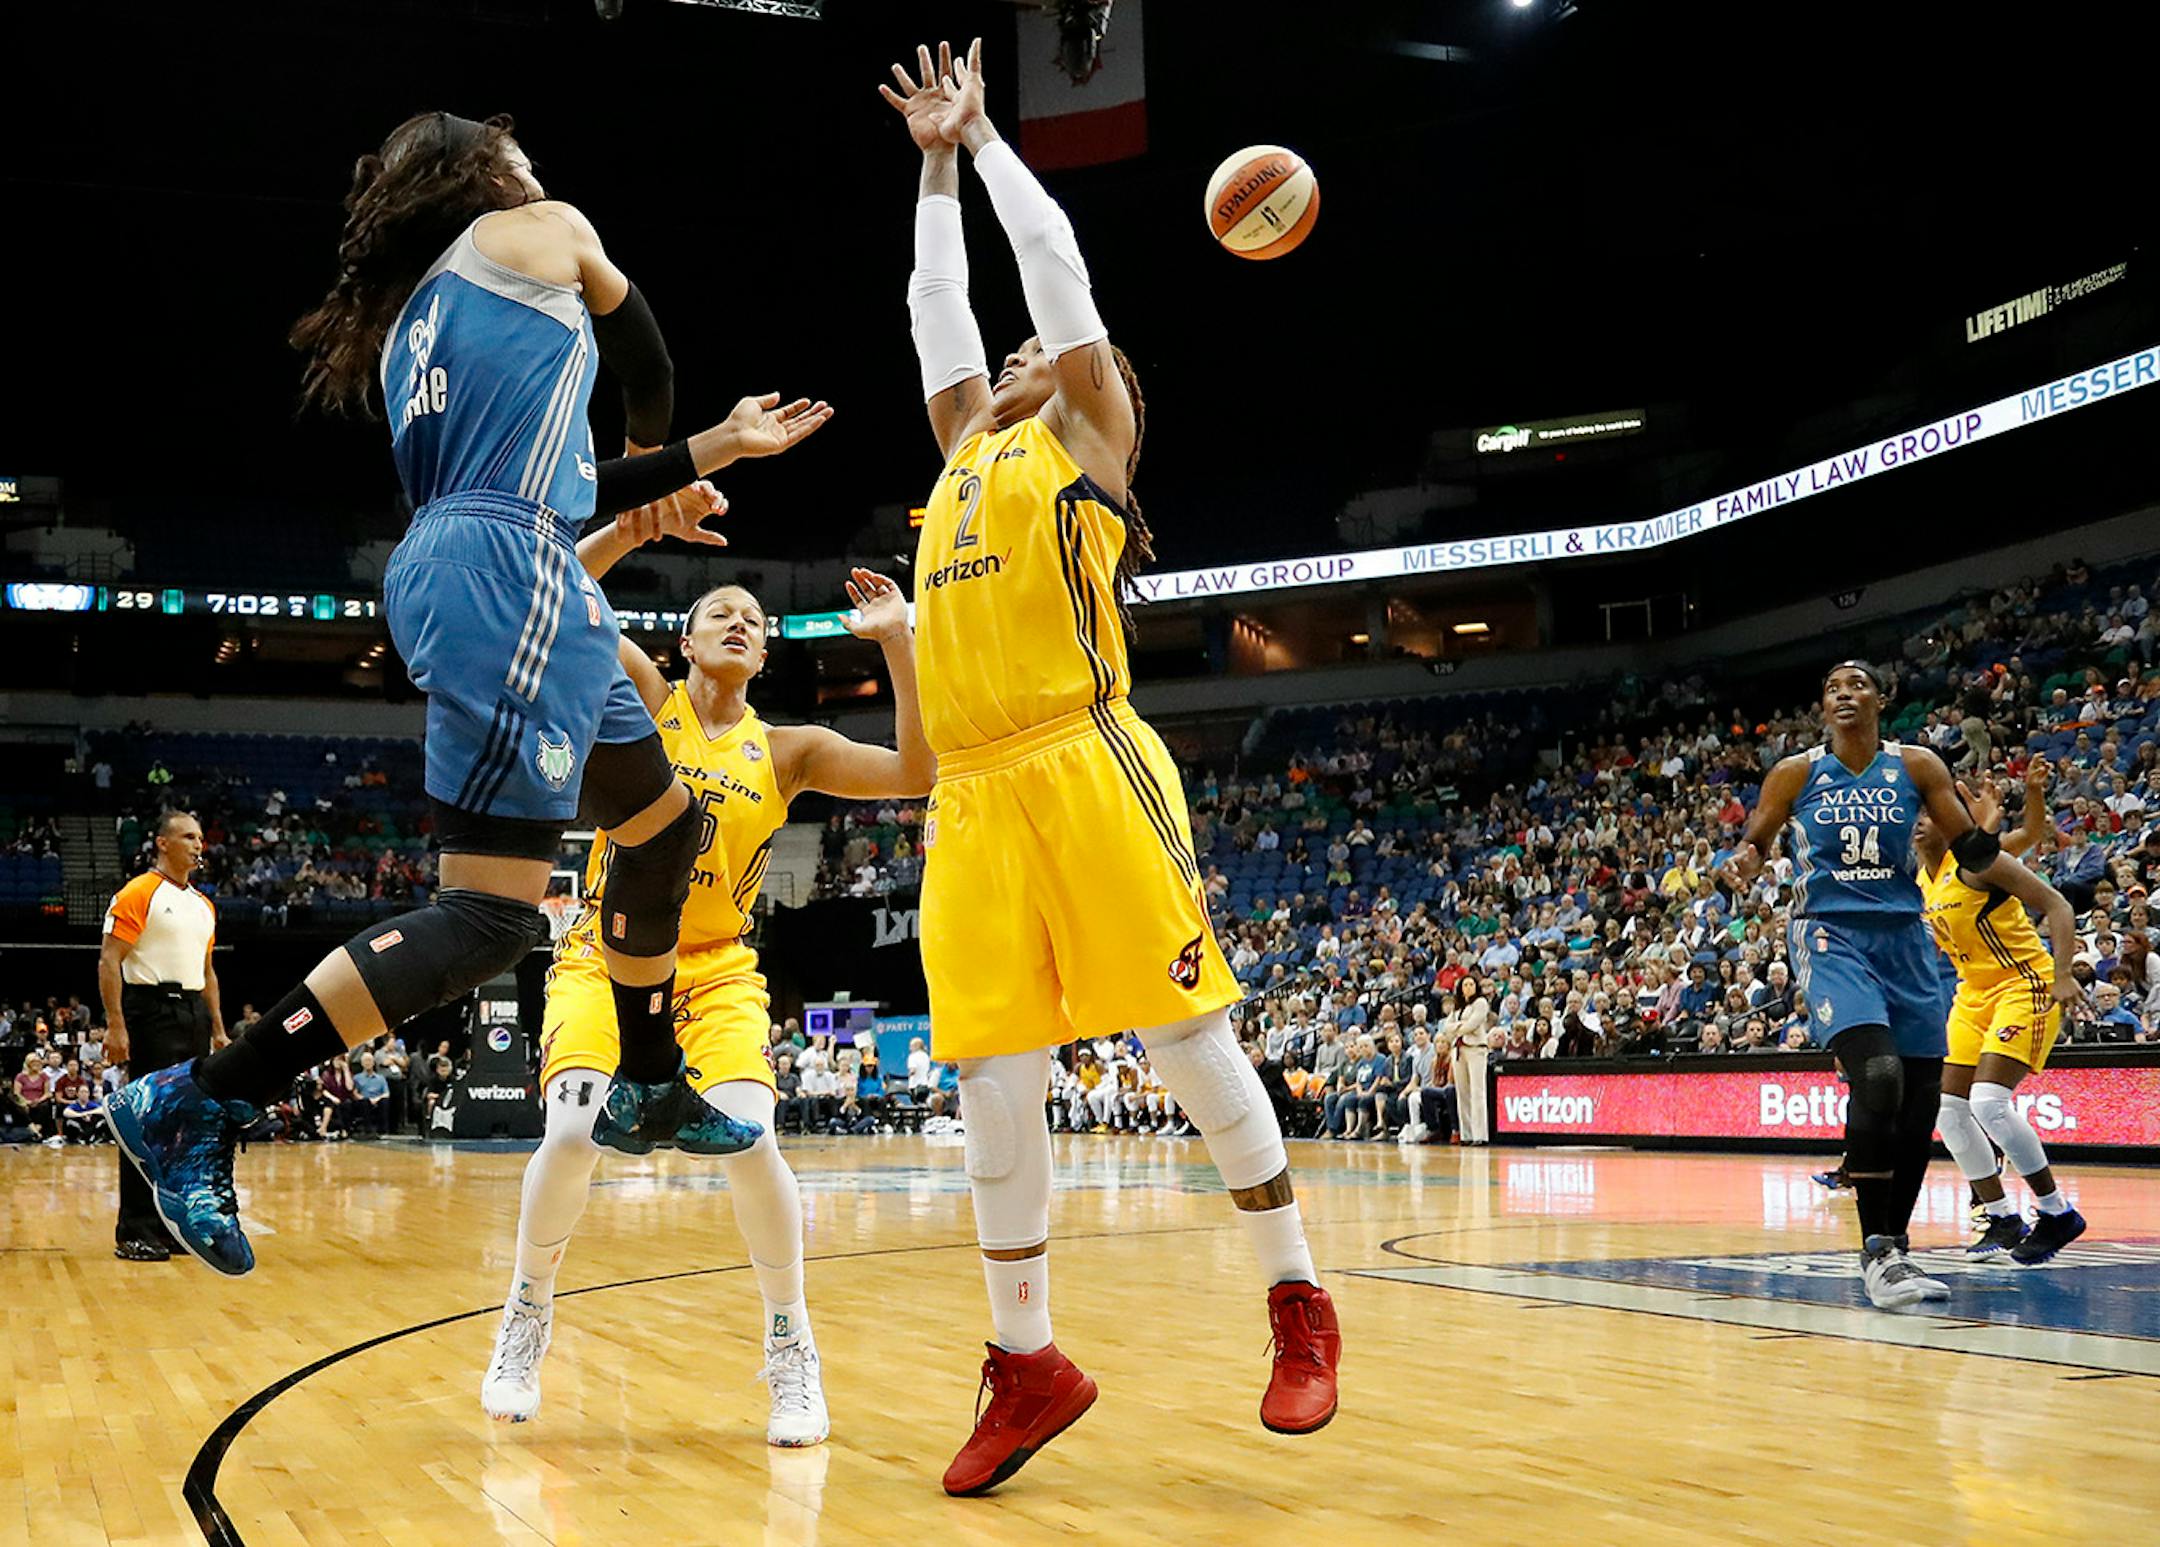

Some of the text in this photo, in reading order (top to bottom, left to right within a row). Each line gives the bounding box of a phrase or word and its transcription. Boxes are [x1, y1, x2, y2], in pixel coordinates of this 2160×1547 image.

[1218, 161, 1287, 223] SPALDING
[1477, 428, 1532, 452] Cargill
[1175, 571, 1238, 595] LAW
[1251, 558, 1354, 586] GROUP
[1402, 534, 1552, 571] MESSERLI
[1565, 532, 1584, 553] &
[1596, 507, 1703, 550] KRAMER
[1716, 473, 1800, 522] FAMILY
[1811, 451, 1868, 490] LAW
[1880, 413, 1982, 466] GROUP
[2021, 349, 2160, 420] MESSER
[954, 475, 981, 550] 2
[924, 554, 1000, 591] verizon
[116, 591, 279, 616] 29 7:02
[344, 600, 376, 617] 21
[806, 620, 833, 632] 2ND
[1821, 788, 1898, 806] MAYO
[1814, 806, 1905, 825] CLINIC
[1840, 825, 1881, 865] 34
[1831, 866, 1891, 881] verizon
[918, 1019, 931, 1032] ZO
[468, 1085, 526, 1100] verizon
[1504, 1089, 1593, 1124] verizon
